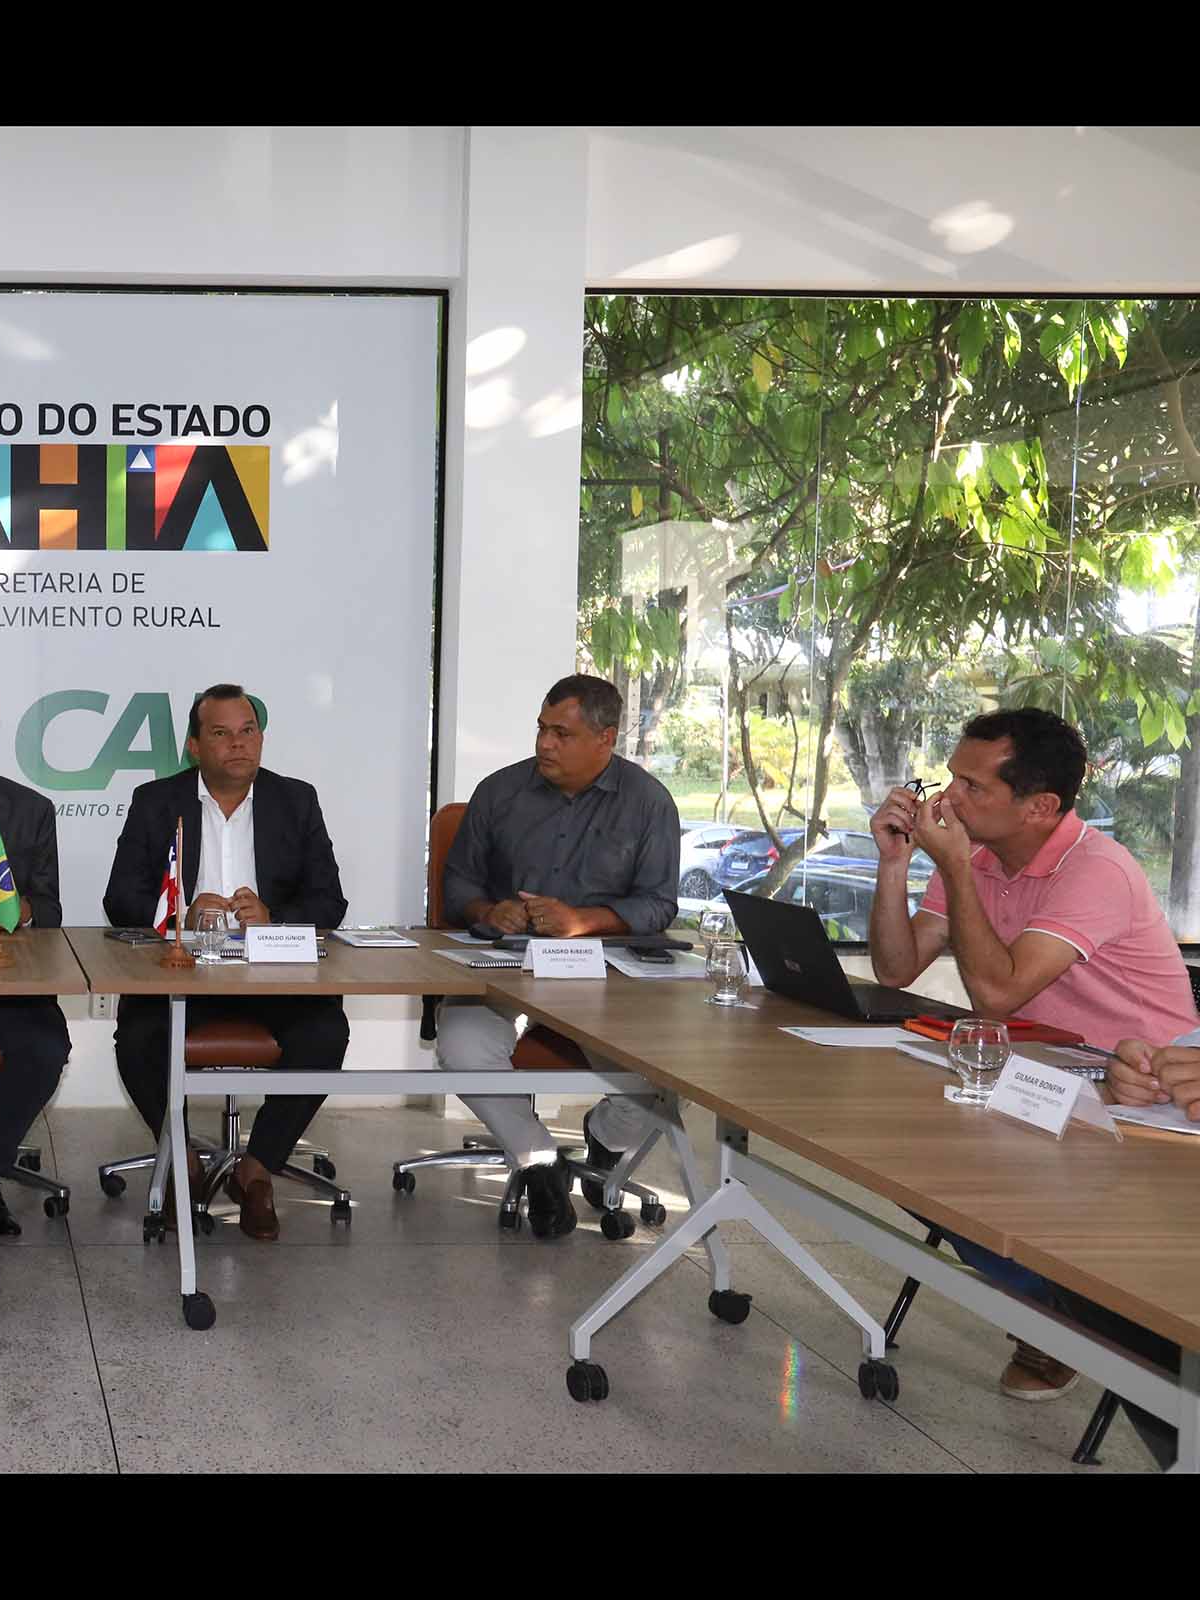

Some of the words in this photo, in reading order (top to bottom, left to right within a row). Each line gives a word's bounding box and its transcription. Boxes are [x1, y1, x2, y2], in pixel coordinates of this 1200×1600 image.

[38, 403, 97, 437] DO
[111, 403, 271, 438] ESTADO
[111, 572, 146, 594] DE
[132, 606, 221, 628] RURAL
[1014, 1071, 1040, 1087] GILMAR
[1039, 1080, 1066, 1096] BONFIM
